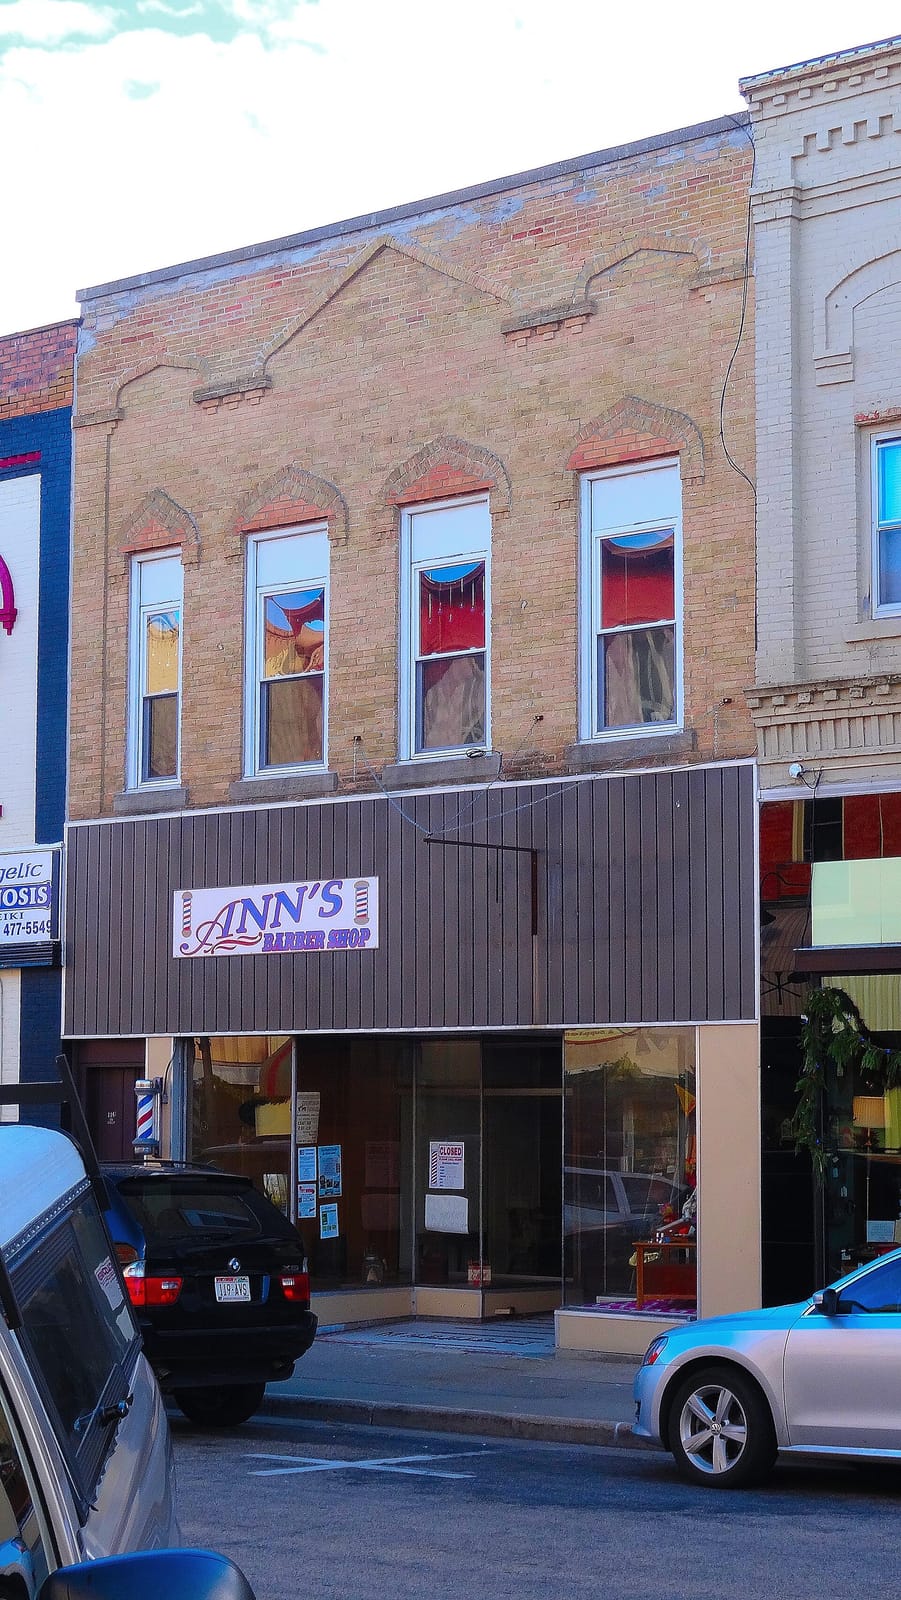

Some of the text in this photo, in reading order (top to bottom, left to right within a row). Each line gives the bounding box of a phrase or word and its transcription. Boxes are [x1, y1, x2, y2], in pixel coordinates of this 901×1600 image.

[0, 886, 48, 908] OSIS
[180, 880, 343, 955] ANN'S
[262, 927, 371, 952] BARBER SHOP
[440, 1146, 462, 1156] CLOSED
